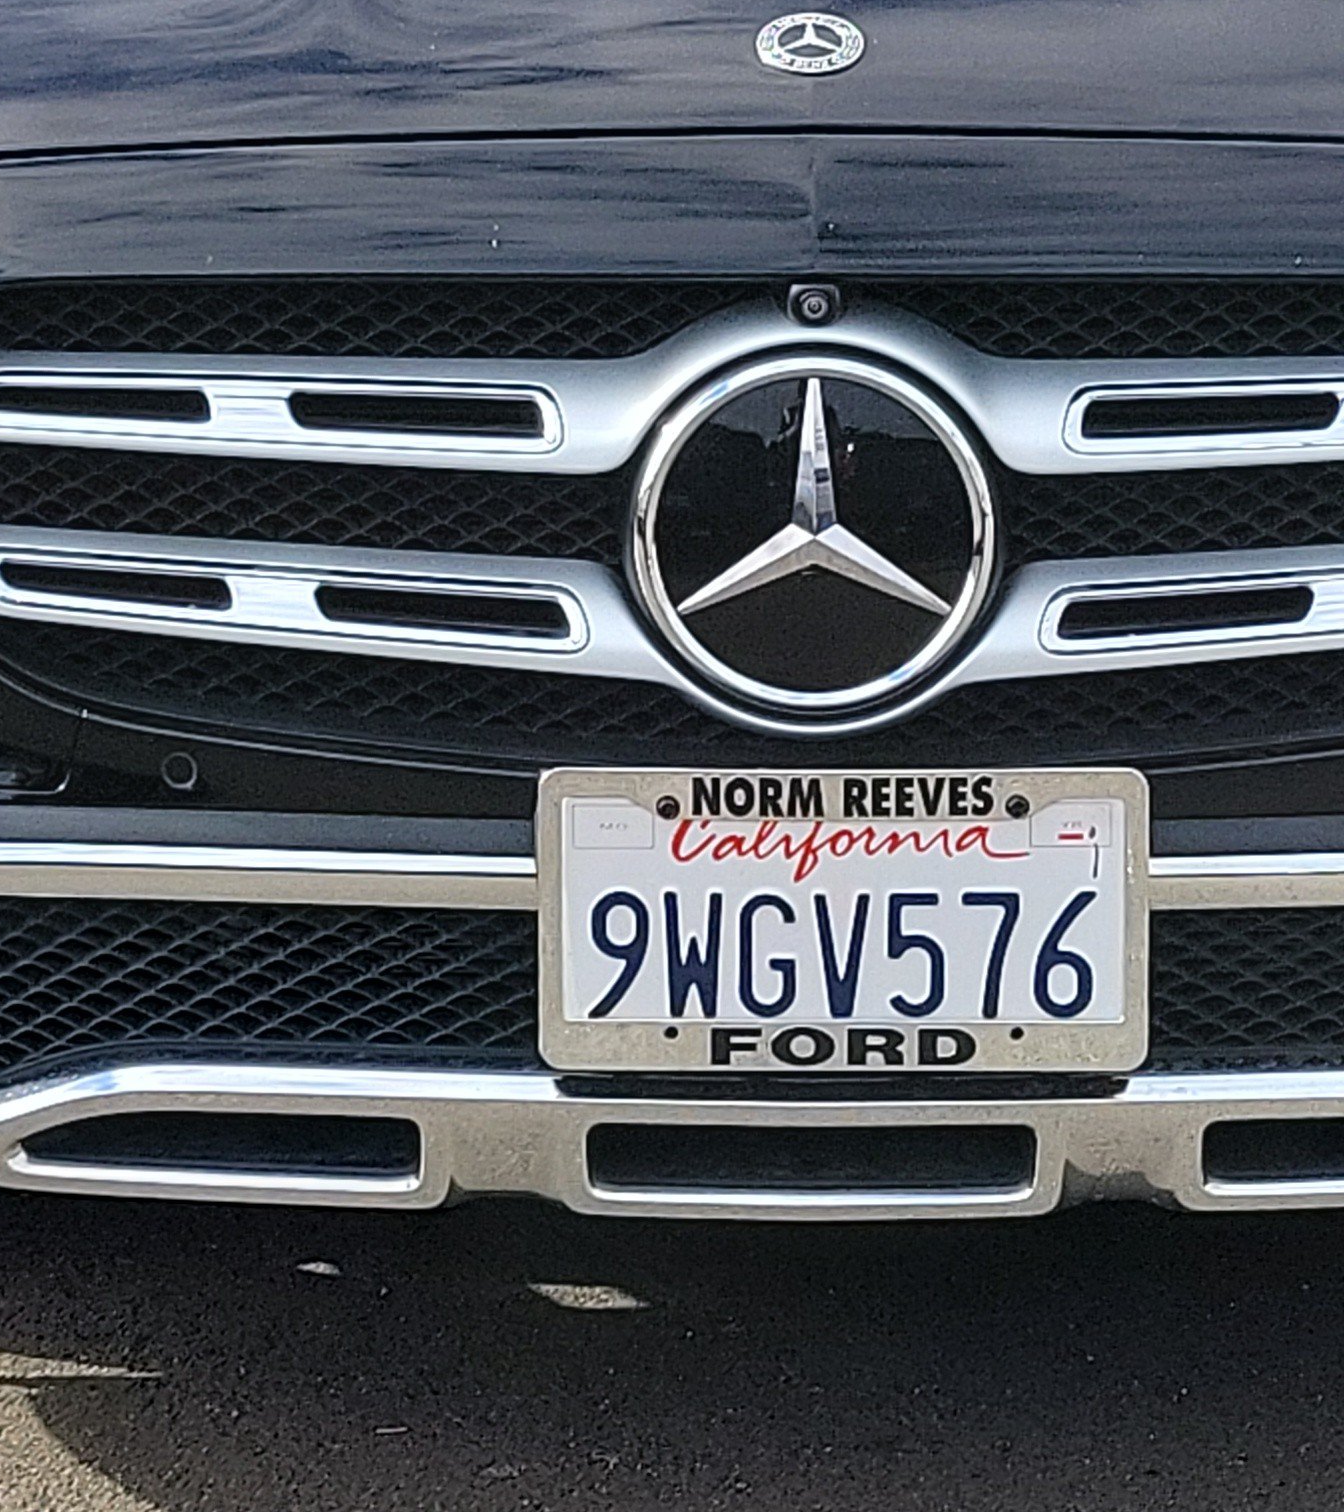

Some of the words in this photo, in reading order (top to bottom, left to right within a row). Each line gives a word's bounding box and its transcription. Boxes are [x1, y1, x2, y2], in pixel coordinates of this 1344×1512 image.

[691, 777, 825, 818] NORM
[843, 776, 994, 818] REEVES
[670, 820, 1030, 883] California
[588, 890, 1099, 1019] 9WGV576
[710, 1027, 977, 1066] FORD
